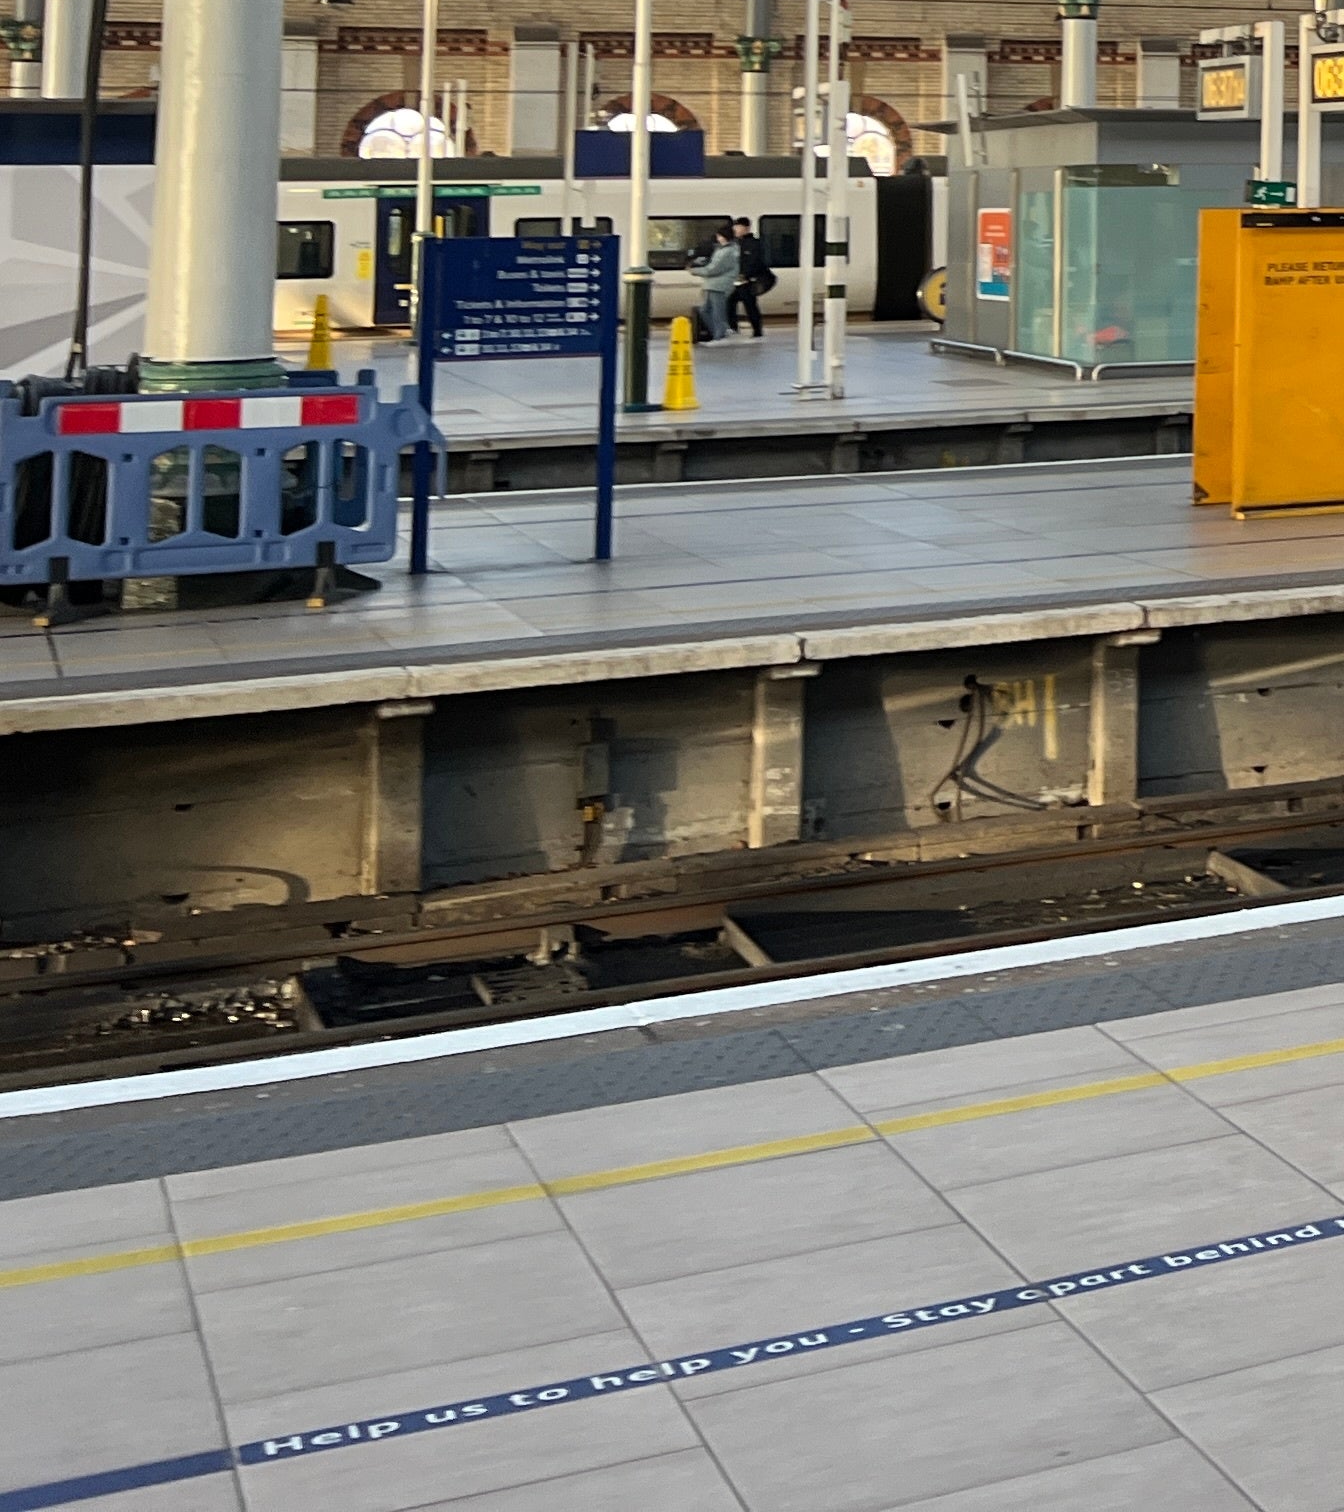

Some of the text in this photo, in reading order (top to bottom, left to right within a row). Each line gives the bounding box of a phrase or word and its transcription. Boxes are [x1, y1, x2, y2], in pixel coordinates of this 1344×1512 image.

[1266, 262, 1309, 272] PLEASE
[1297, 274, 1330, 285] AFTER
[262, 1418, 401, 1458] Help
[425, 1401, 488, 1424] us
[508, 1386, 570, 1408] to
[590, 1356, 712, 1391] help
[728, 1330, 829, 1364] you
[882, 1293, 998, 1329] Stay
[1016, 1261, 1152, 1301] apart
[1163, 1226, 1322, 1269] behind
